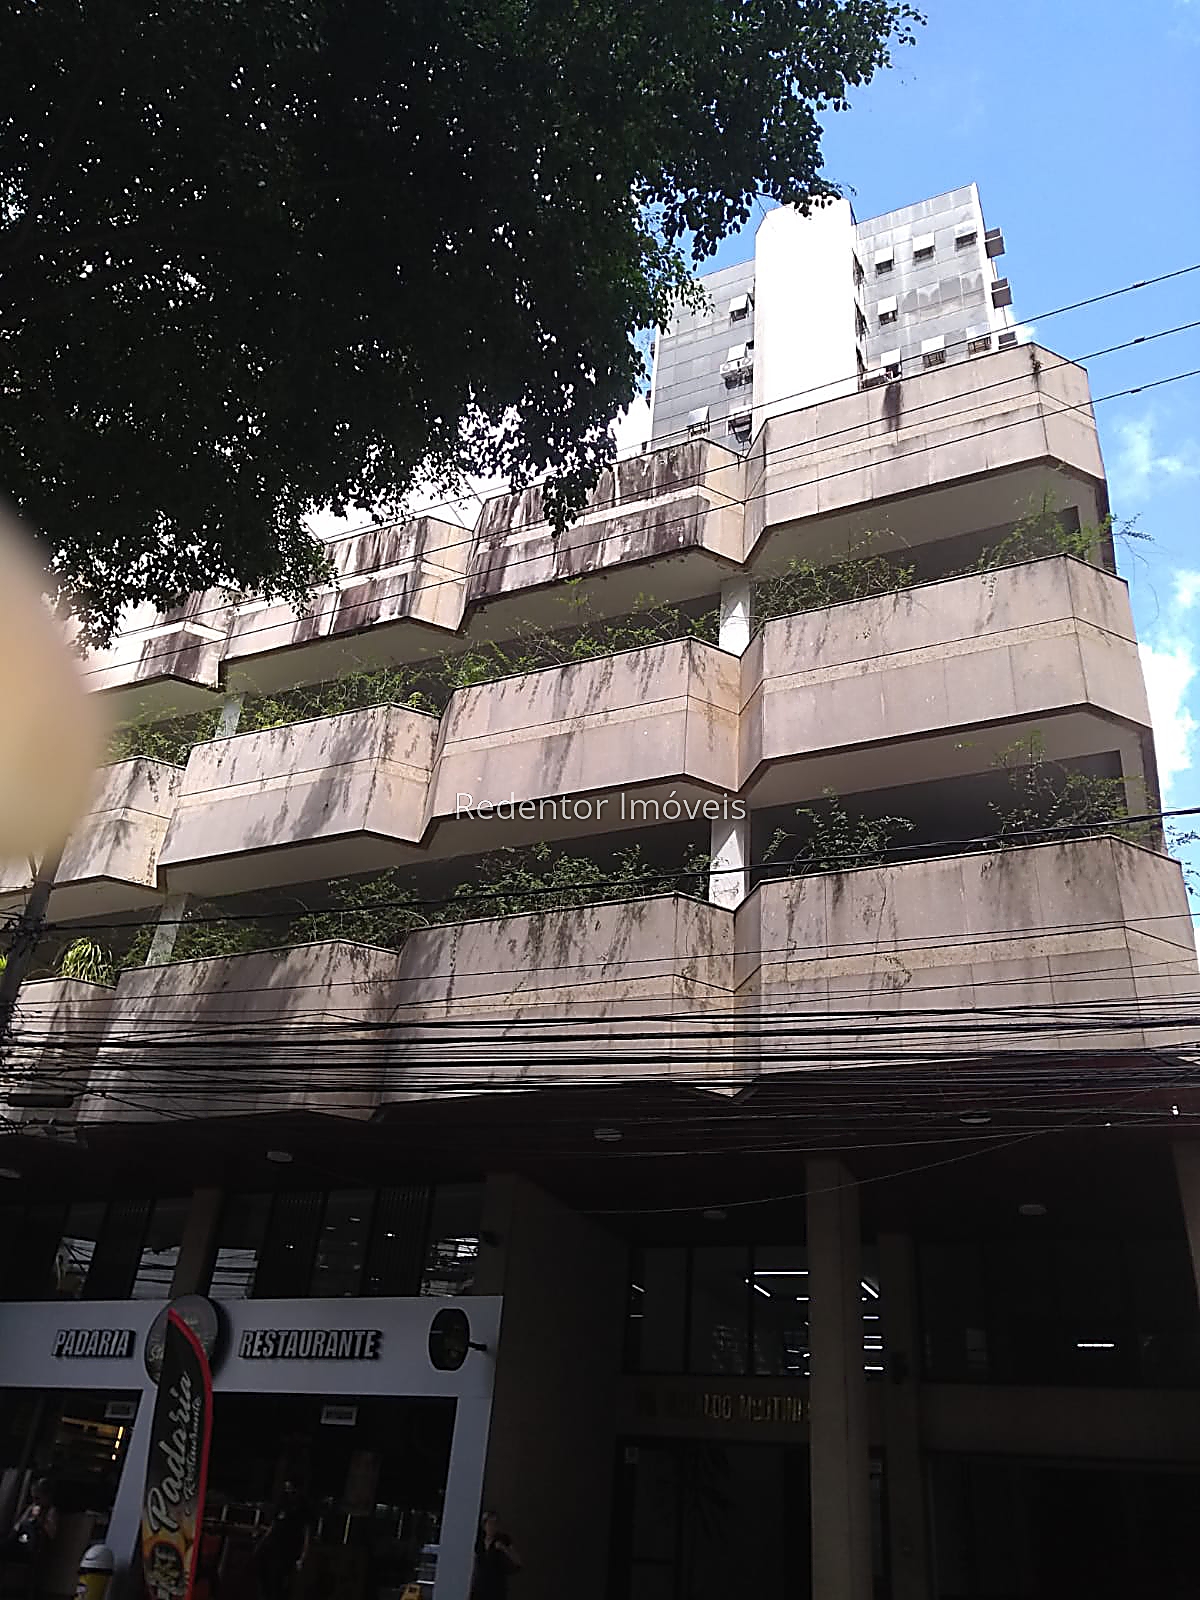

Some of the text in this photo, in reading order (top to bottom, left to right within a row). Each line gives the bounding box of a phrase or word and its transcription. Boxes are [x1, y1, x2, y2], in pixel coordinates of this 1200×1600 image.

[53, 1329, 133, 1356] PADARIA
[240, 1330, 379, 1358] RESTAURANTE
[147, 1371, 191, 1535] Padaria
